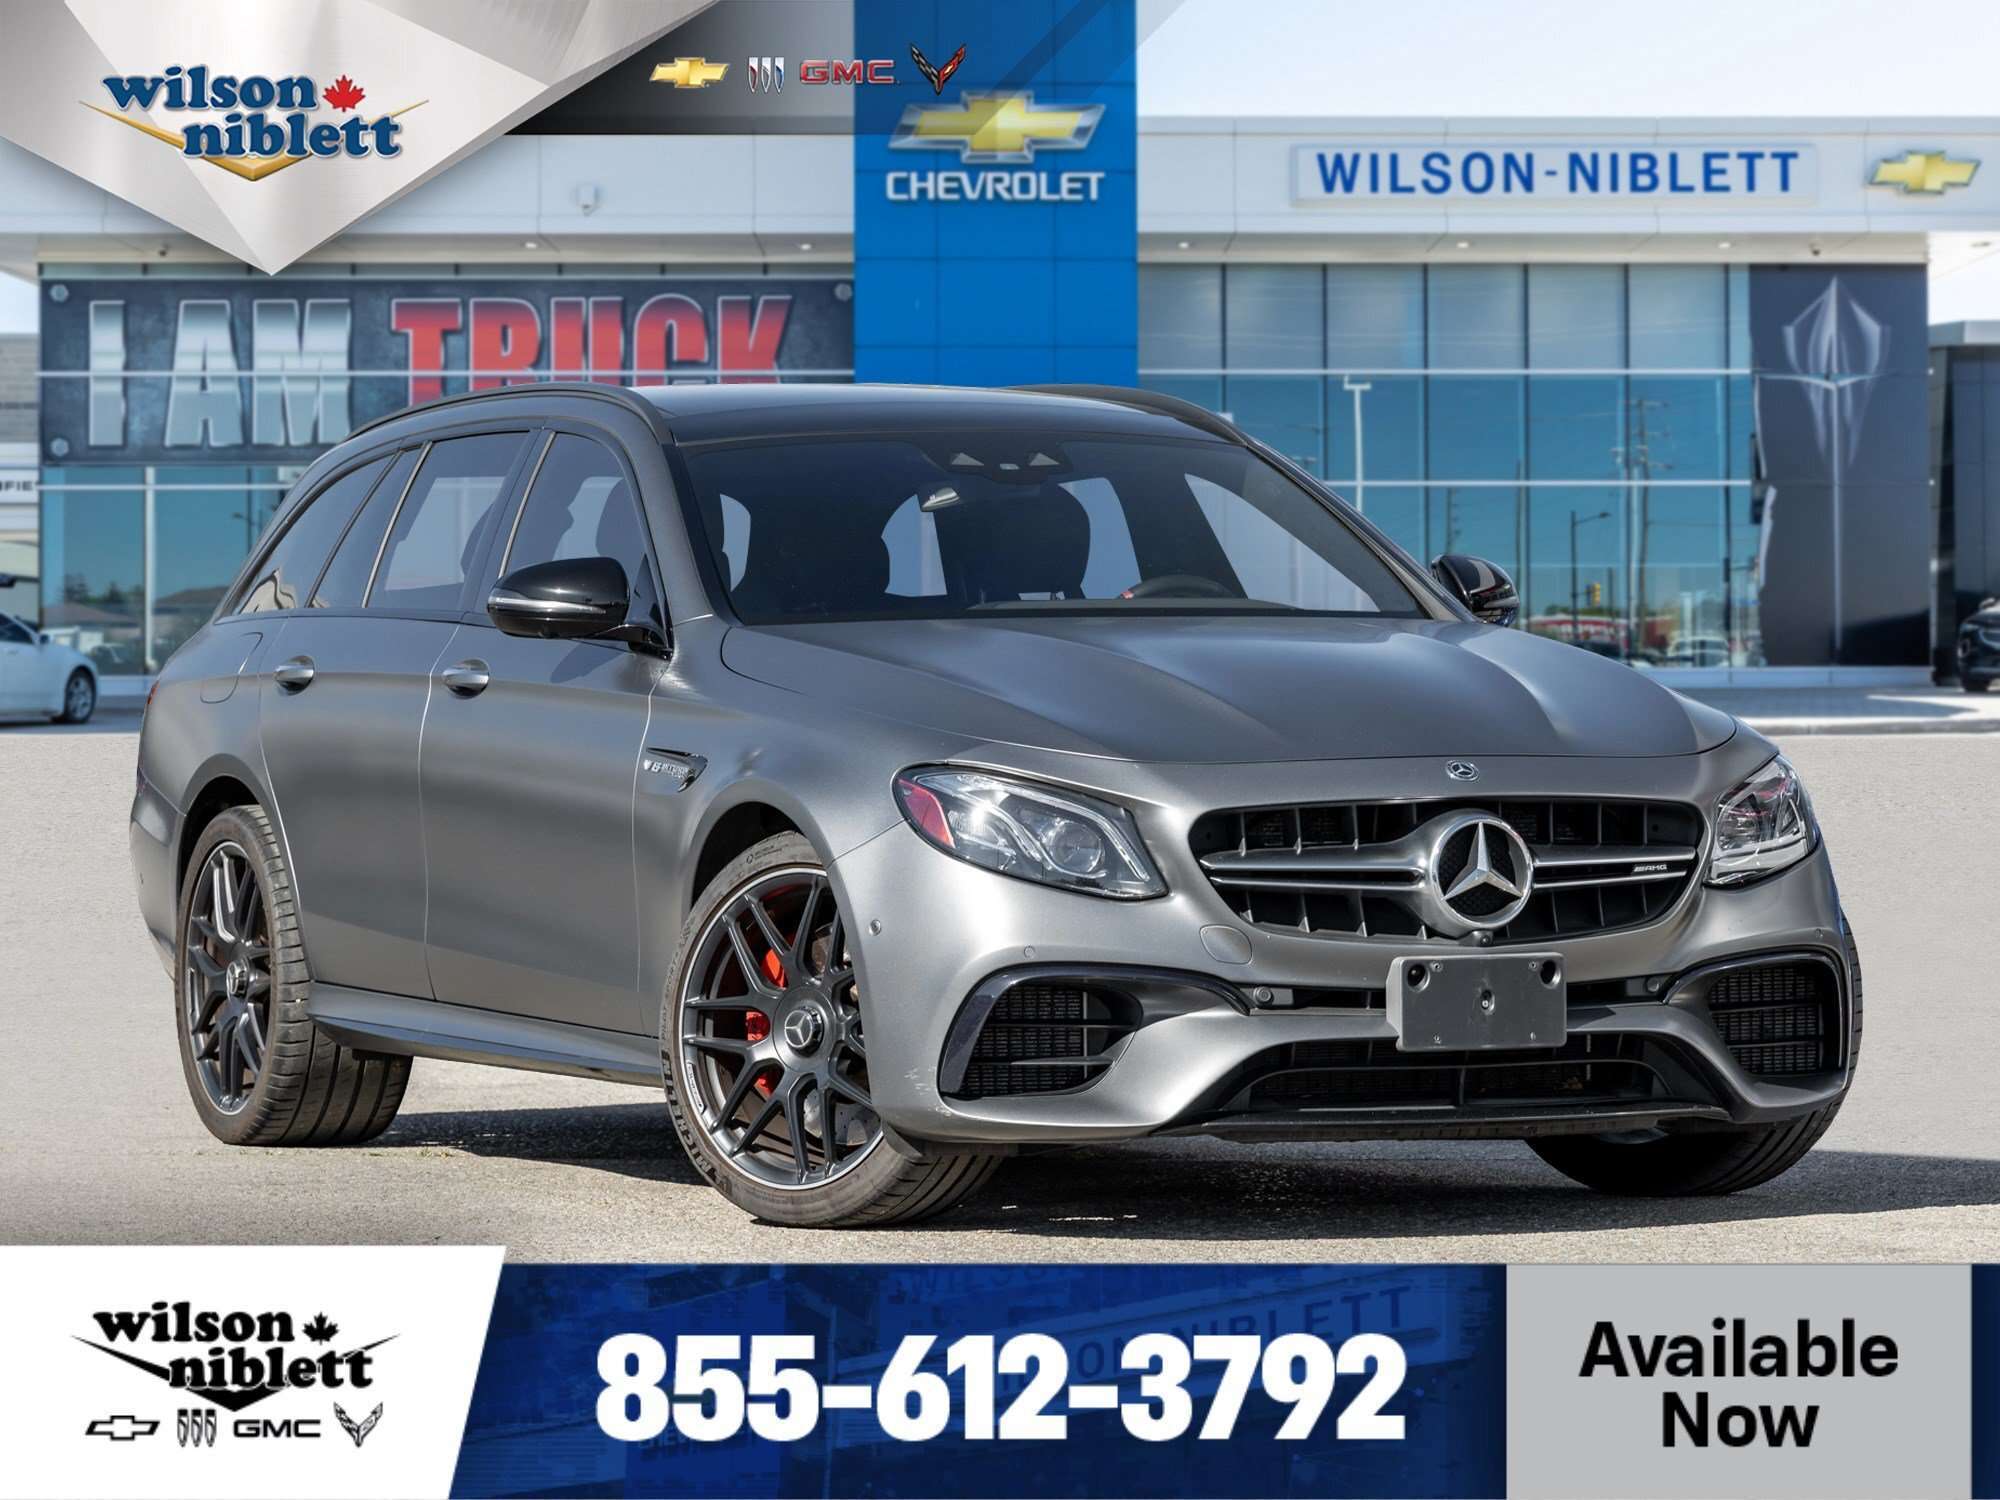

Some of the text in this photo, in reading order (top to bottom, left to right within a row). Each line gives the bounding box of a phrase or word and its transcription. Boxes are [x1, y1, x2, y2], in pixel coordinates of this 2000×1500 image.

[885, 170, 1105, 201] CHEVROLET
[1316, 151, 1799, 194] WILSON-NIBLETT
[89, 293, 793, 447] I AM TRUCK
